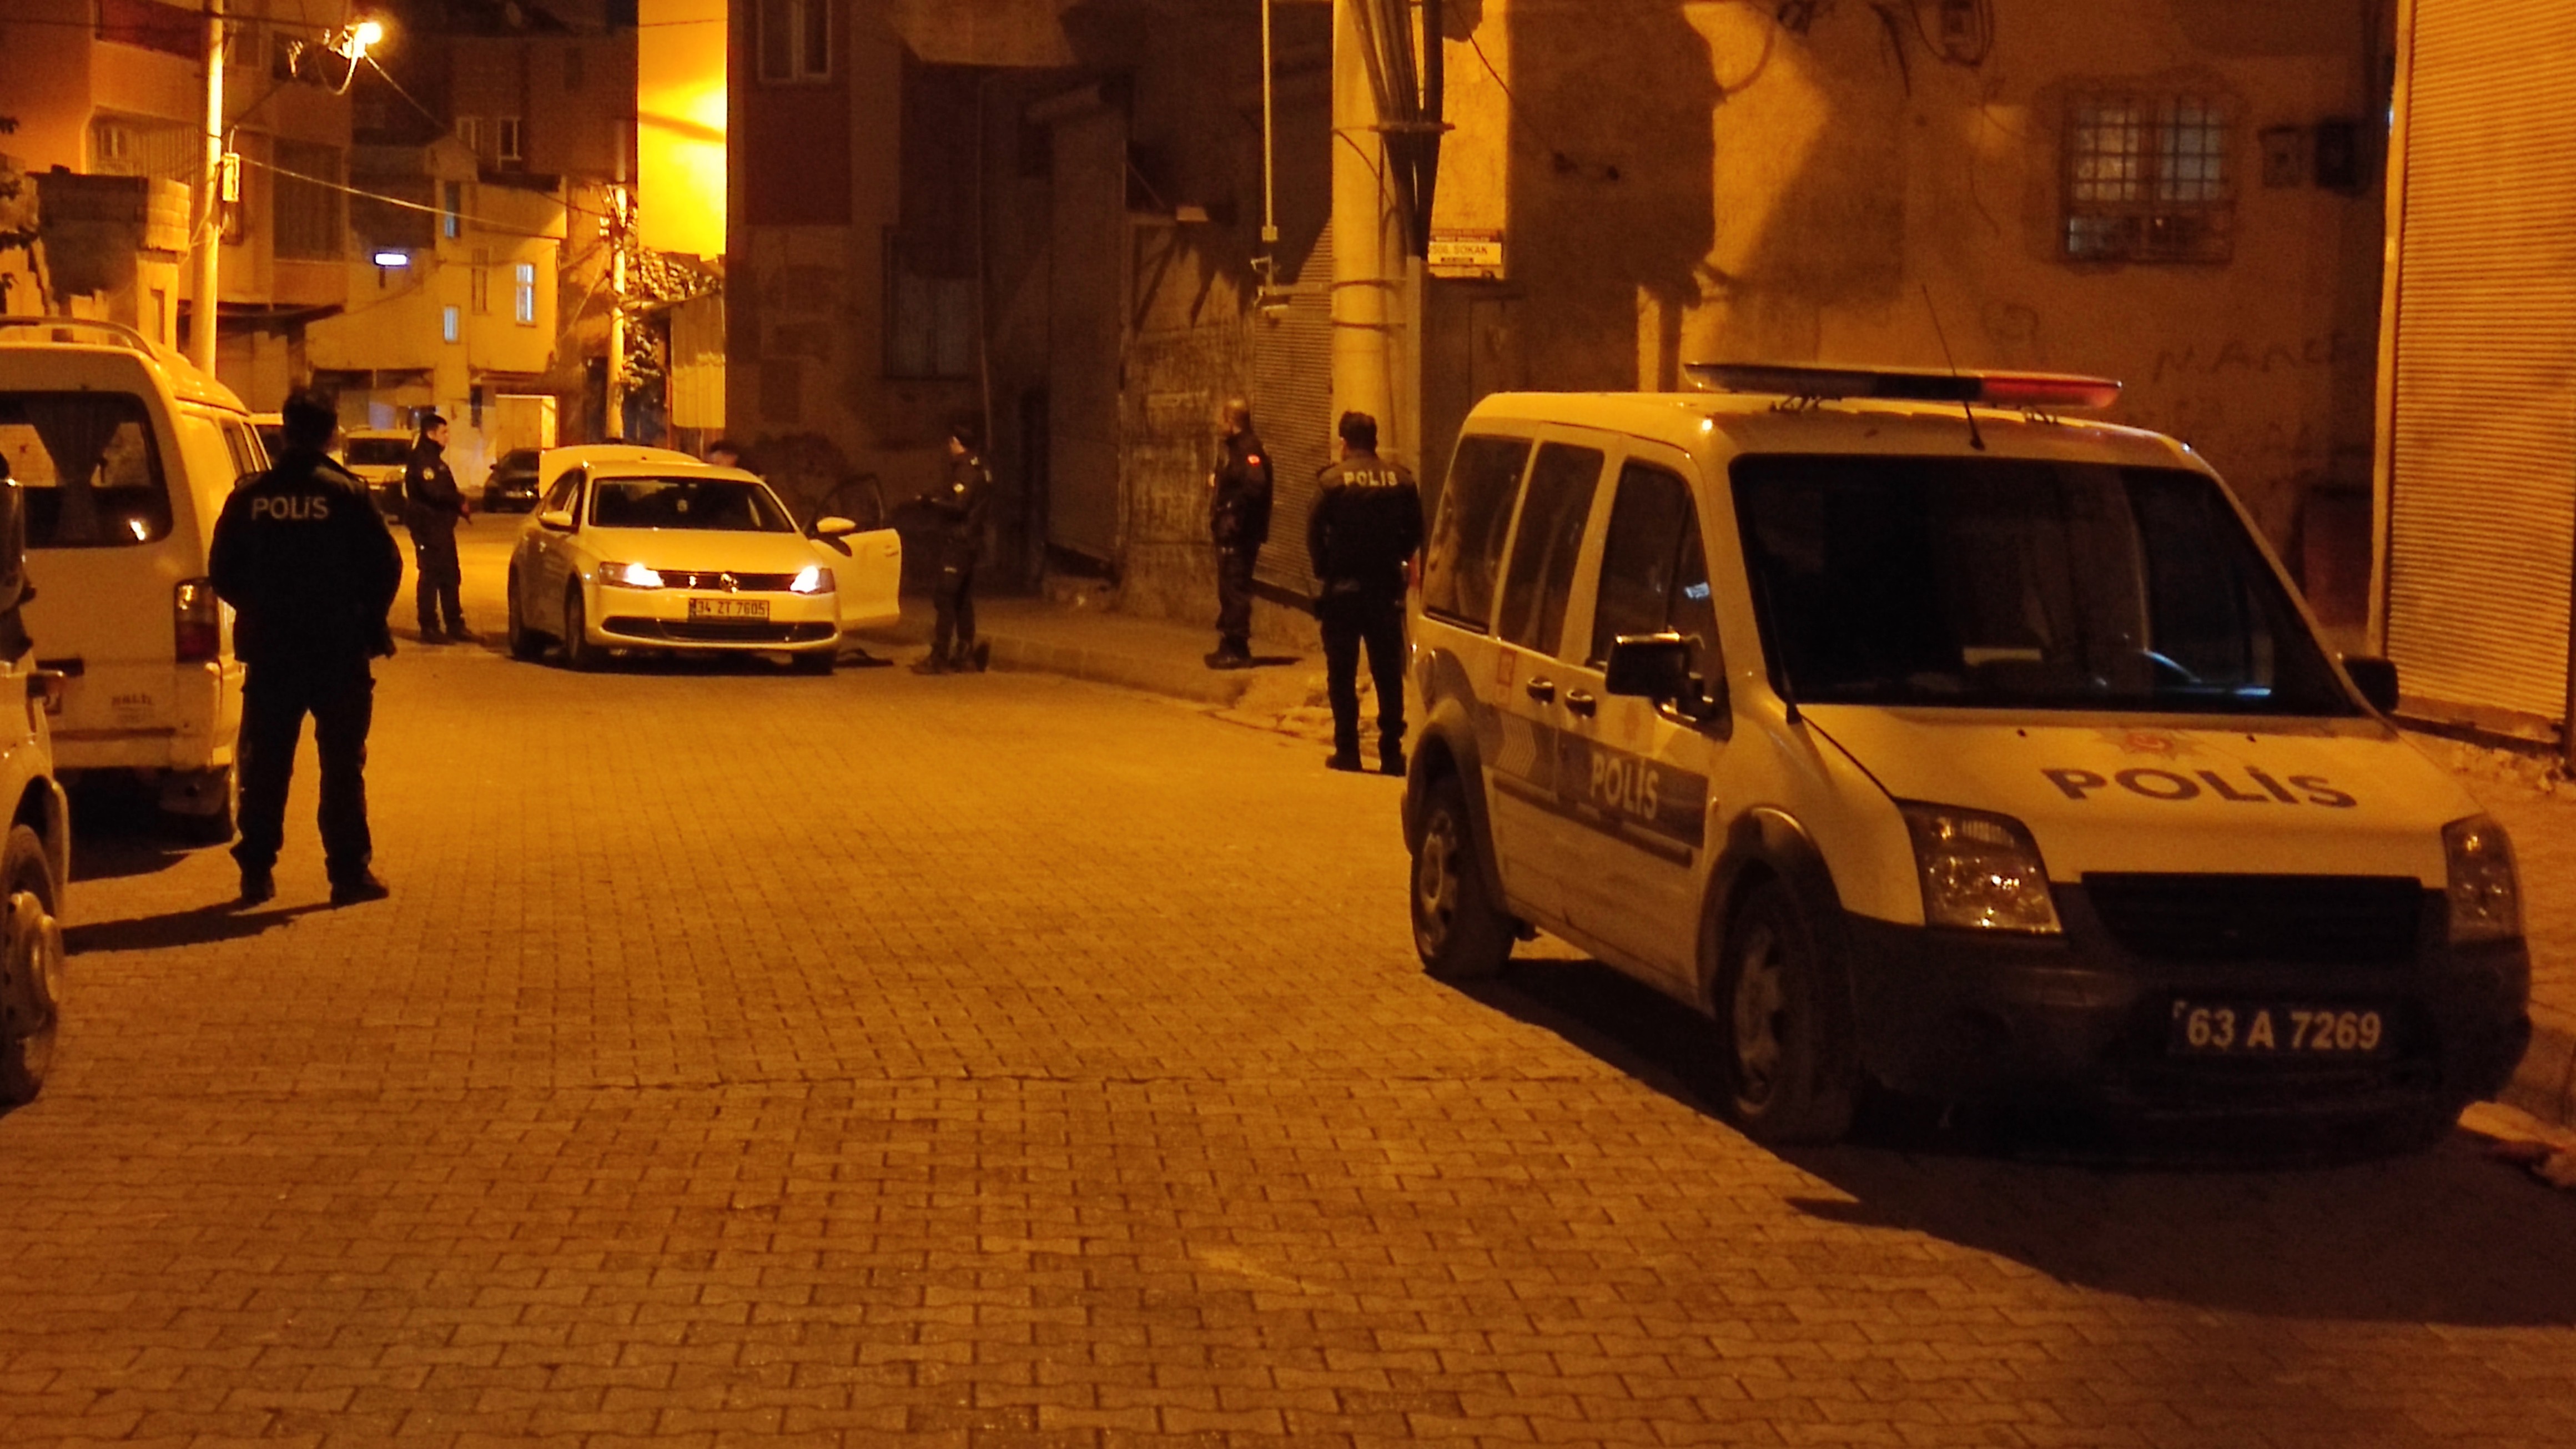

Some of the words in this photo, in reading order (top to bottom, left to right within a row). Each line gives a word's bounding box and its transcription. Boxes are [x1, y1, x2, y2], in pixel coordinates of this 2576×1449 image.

[698, 601, 711, 612] 34
[718, 601, 731, 614] ZT
[1589, 751, 1659, 820] POLİS
[2040, 766, 2358, 808] POLİS
[2187, 1009, 2236, 1050] 63
[2246, 1010, 2276, 1049] A
[2291, 1011, 2382, 1050] 7269
